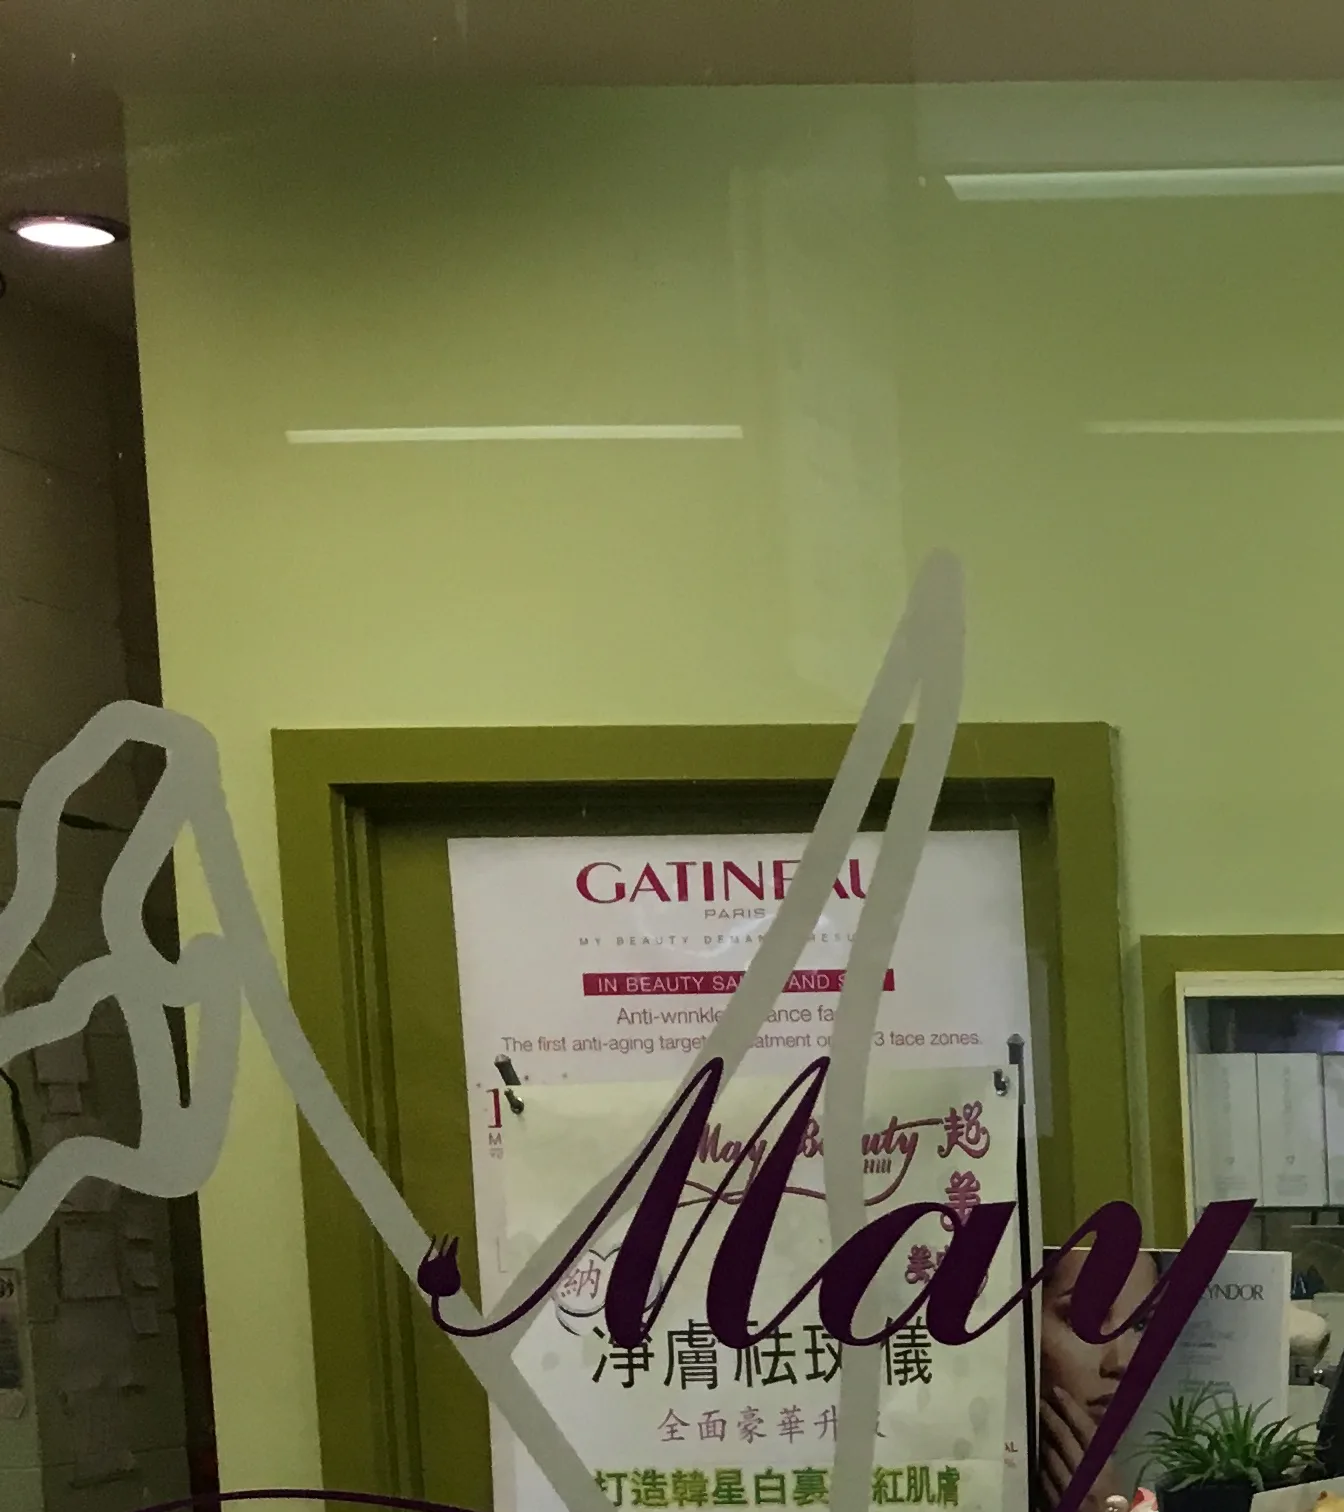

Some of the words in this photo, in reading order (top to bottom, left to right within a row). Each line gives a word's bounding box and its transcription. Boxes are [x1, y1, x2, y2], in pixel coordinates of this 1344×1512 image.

[704, 907, 767, 920] PARIS
[598, 976, 618, 993] IN
[625, 974, 704, 994] BEAUTY
[788, 973, 831, 991] AND
[502, 1036, 533, 1053] The
[537, 1035, 567, 1052] first
[571, 1035, 654, 1055] anti-aging
[873, 1031, 886, 1047] 3
[889, 1030, 926, 1047] face
